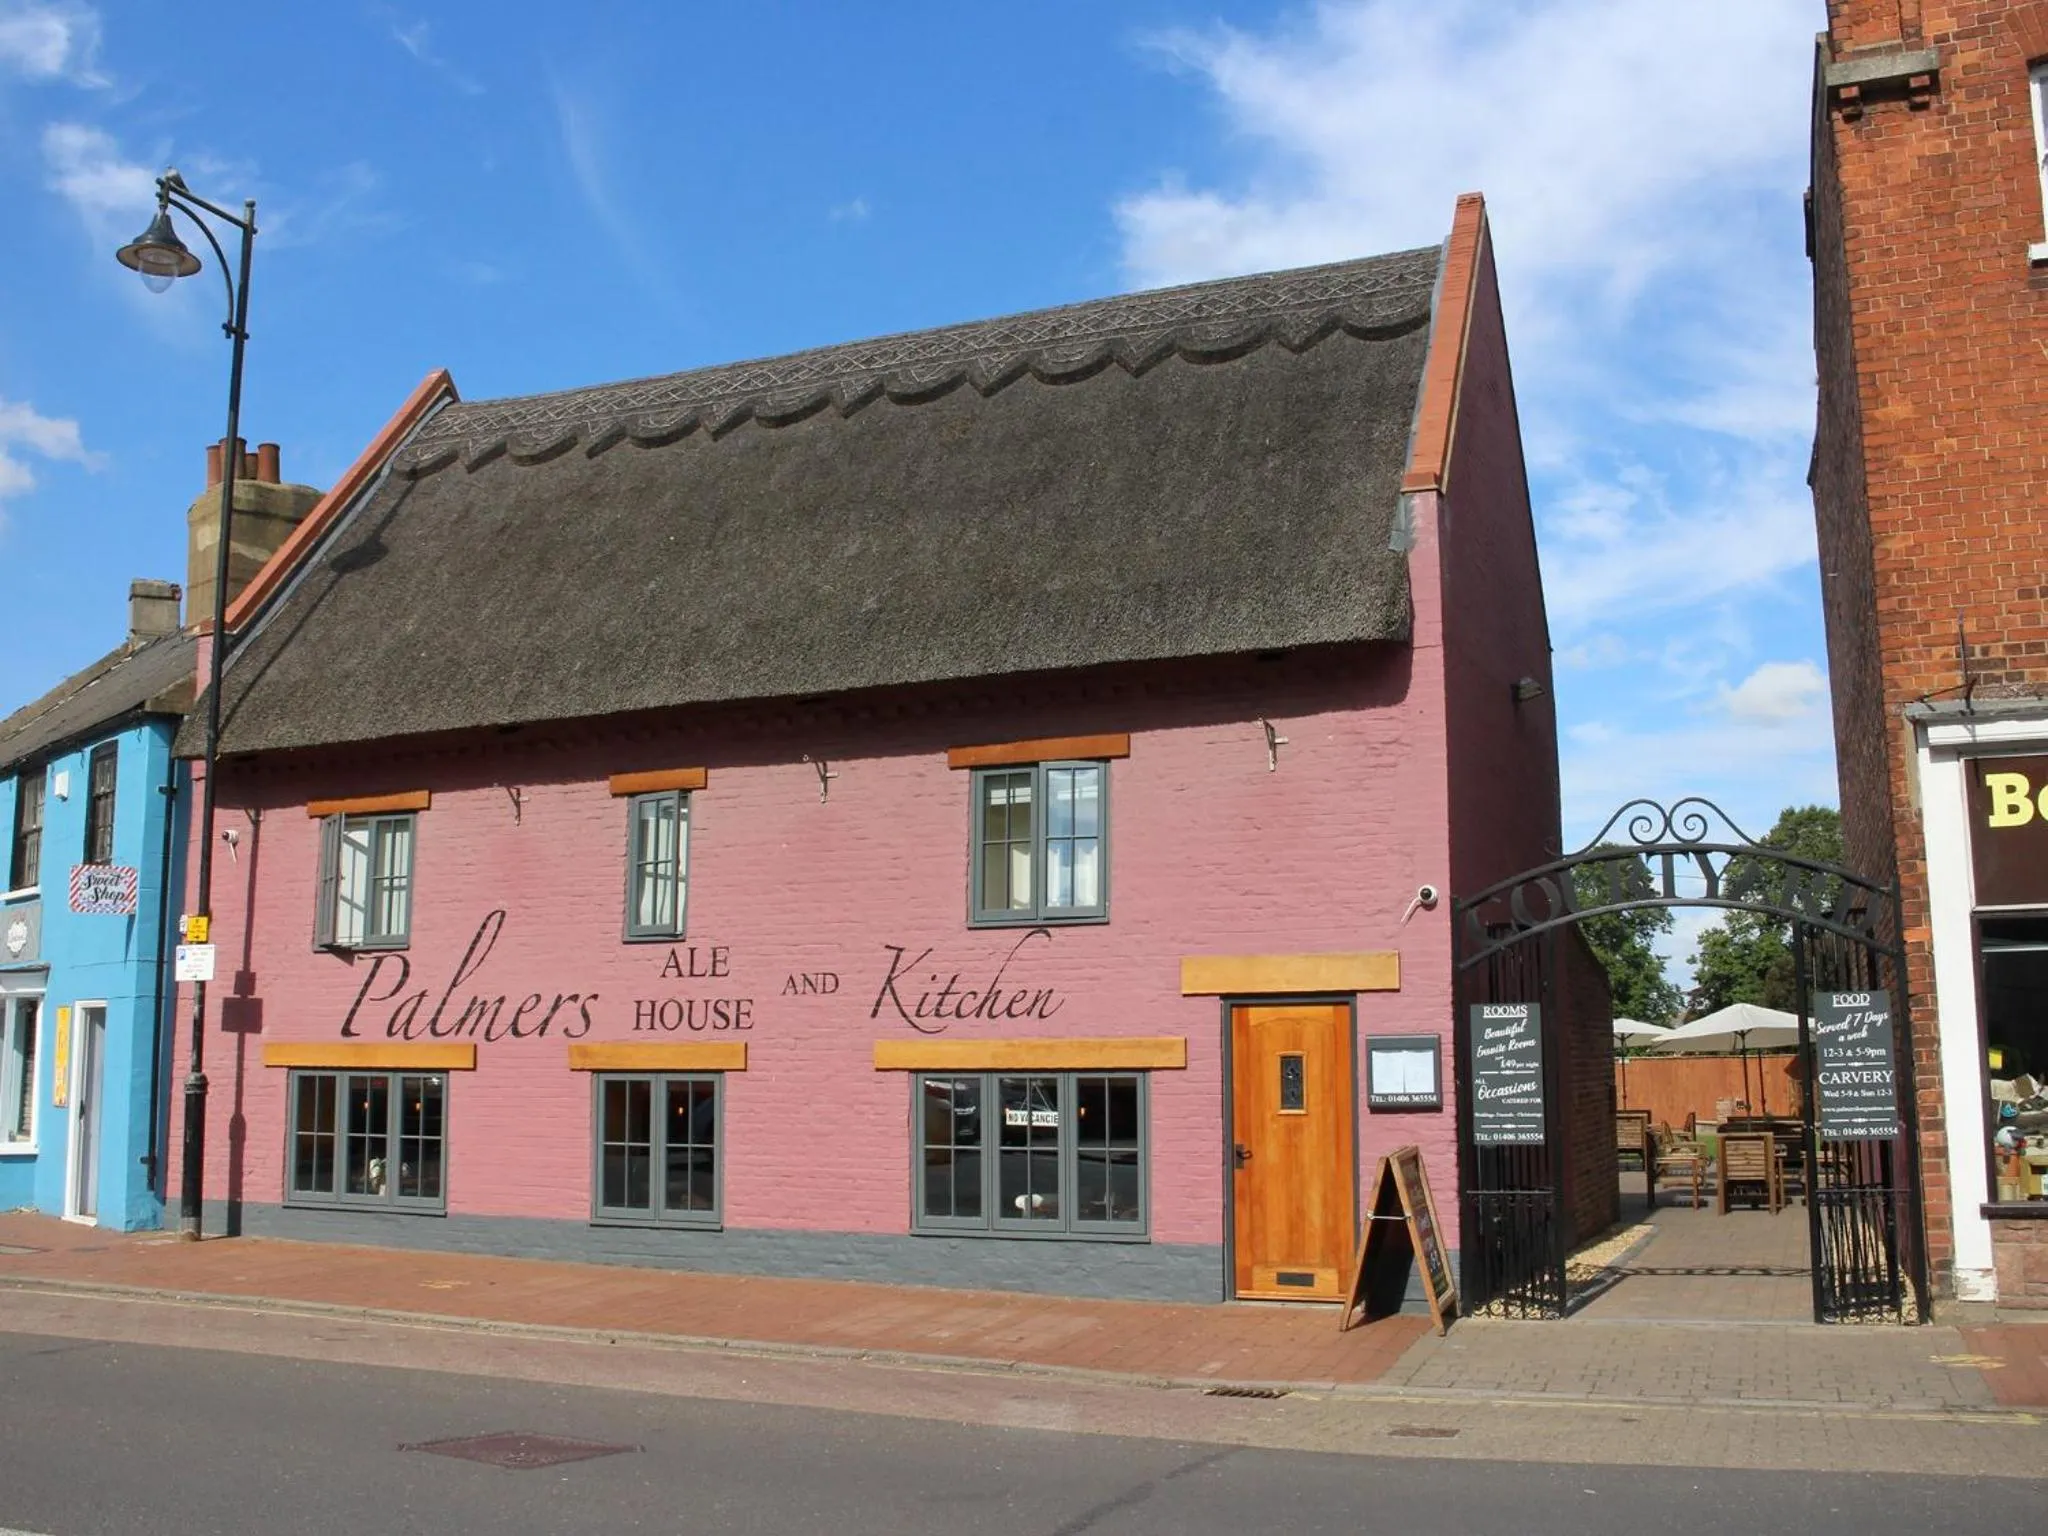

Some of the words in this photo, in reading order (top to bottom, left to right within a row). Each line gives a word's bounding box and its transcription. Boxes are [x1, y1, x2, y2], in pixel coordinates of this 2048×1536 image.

[1985, 772, 2048, 828] B
[80, 873, 121, 891] Sweet
[89, 887, 126, 905] Shop
[1466, 850, 1882, 947] COURTYARD
[660, 946, 730, 978] ALE
[340, 909, 598, 1042] Palmers
[780, 972, 839, 996] AND
[870, 927, 1065, 1034] Kitchen
[1832, 993, 1871, 1007] FOOD
[633, 998, 755, 1031] HOUSE
[1483, 1005, 1528, 1018] ROOMS
[1484, 1018, 1528, 1039] Beautiful
[1816, 1014, 1852, 1035] Served
[1853, 1013, 1863, 1027] 7
[1864, 1011, 1888, 1027] Days
[1846, 1024, 1868, 1040] week
[1476, 1044, 1507, 1058] Ensuite
[1508, 1038, 1537, 1051] Rooms
[1823, 1047, 1844, 1057] 12-3
[1819, 1070, 1894, 1085] CARVERY
[1478, 1081, 1538, 1100] Occassions
[1008, 1113, 1018, 1122] NO
[1475, 1132, 1492, 1141] TEL:
[1823, 1128, 1840, 1137] TEL:
[1842, 1127, 1867, 1136] 01406
[1869, 1127, 1898, 1136] 365554
